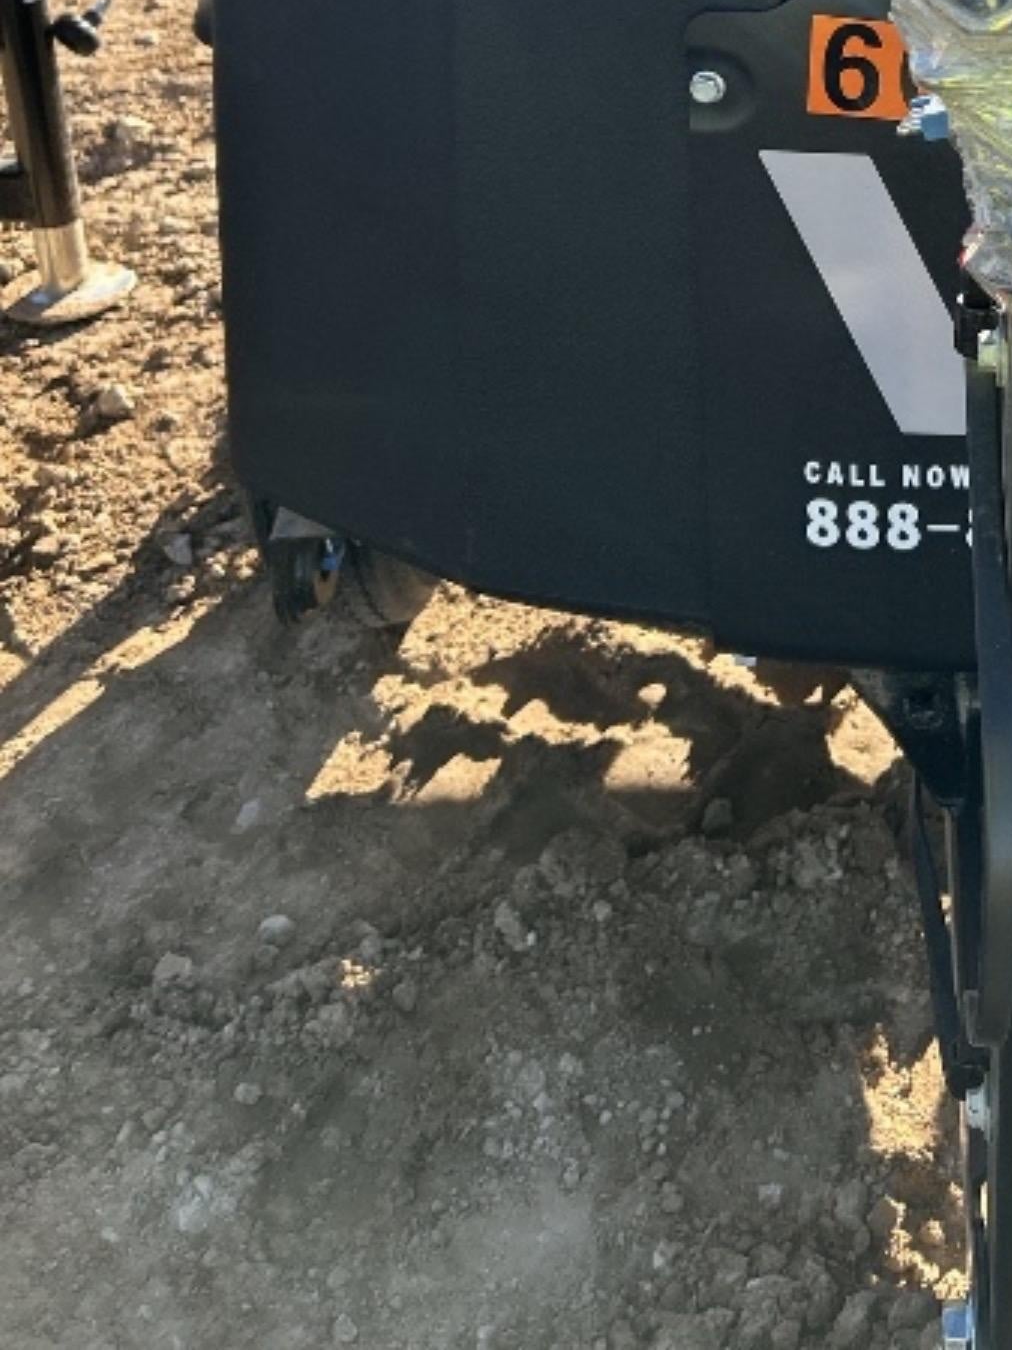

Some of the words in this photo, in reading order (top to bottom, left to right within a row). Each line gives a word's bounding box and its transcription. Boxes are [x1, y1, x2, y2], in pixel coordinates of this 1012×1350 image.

[803, 461, 887, 487] CALL
[902, 463, 970, 490] NOW
[806, 498, 973, 550] 888-
